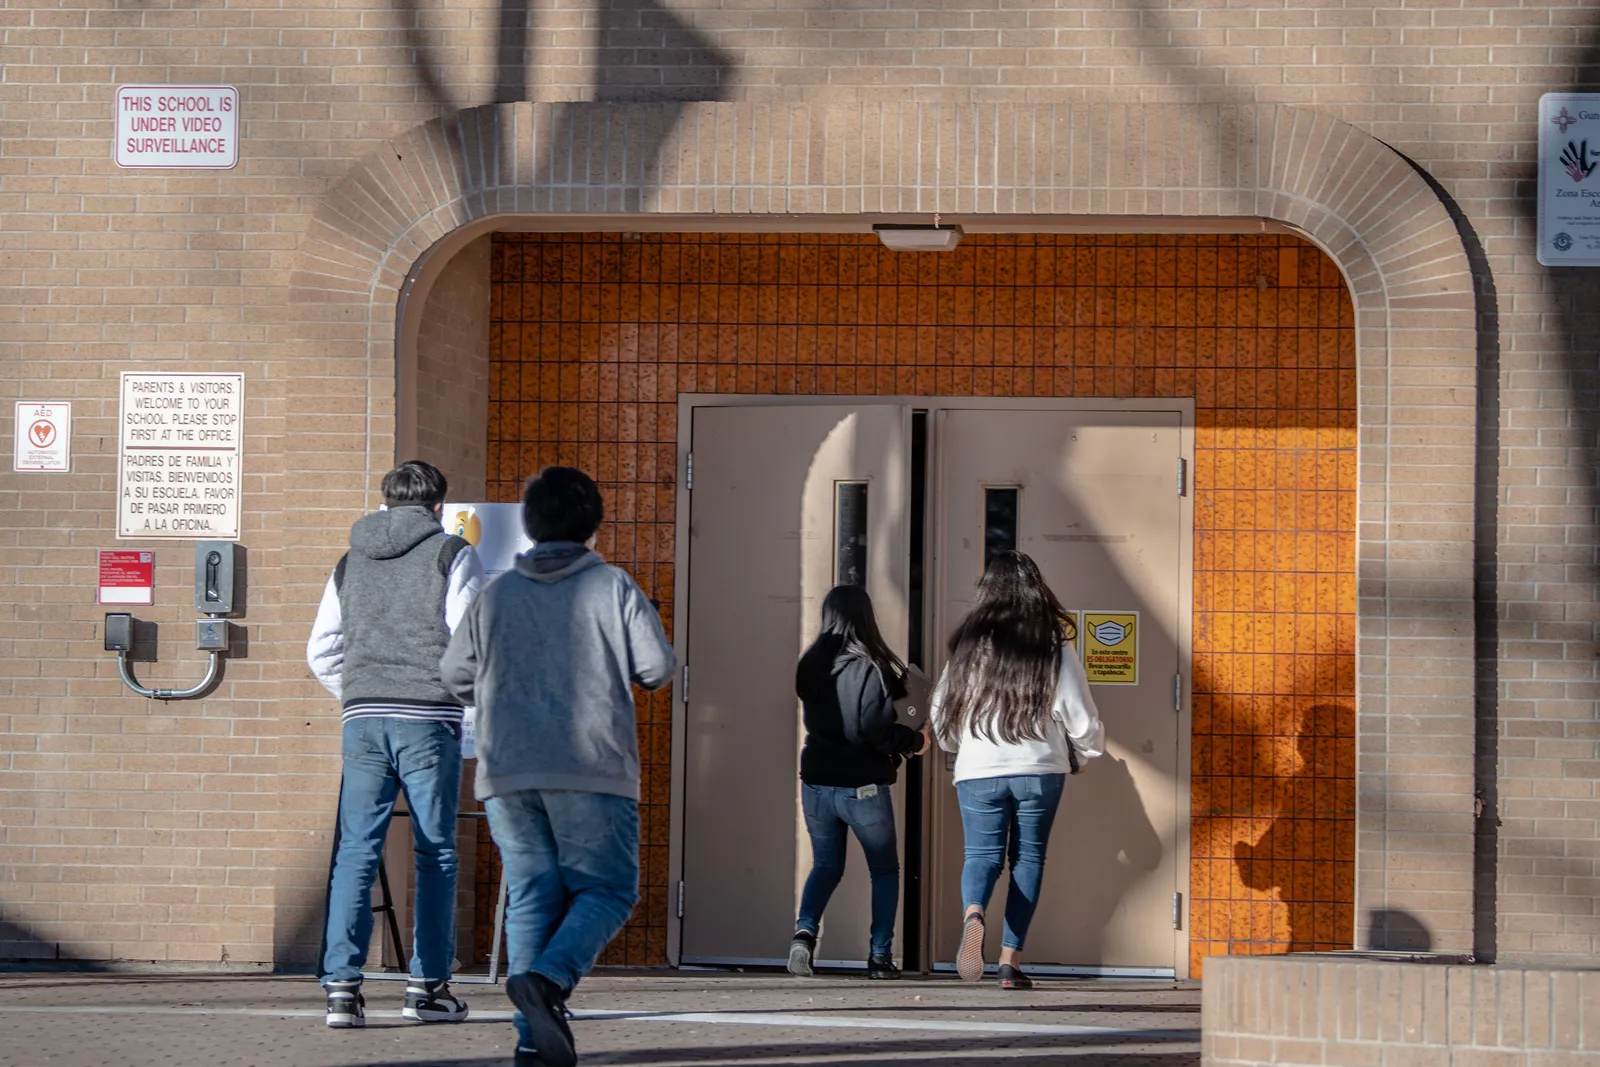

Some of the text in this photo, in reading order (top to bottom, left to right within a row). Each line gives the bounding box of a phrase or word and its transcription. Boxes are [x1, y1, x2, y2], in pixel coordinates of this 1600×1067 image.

[122, 96, 232, 112] THIS SCHOOL IS
[131, 117, 222, 132] UNDER VIDEO
[126, 138, 226, 153] SURVEILLANCE
[1555, 188, 1579, 198] Zona
[132, 381, 175, 393] PARENTS
[179, 382, 185, 394] &
[135, 397, 230, 410] WELCOME TO YOUR
[33, 409, 53, 417] AED
[172, 413, 208, 425] PLEASE
[212, 413, 237, 425] STOP
[130, 429, 234, 441] FIRST AT THE OFFICE.
[126, 455, 233, 468] PADRES DE FAMILIA Y
[126, 471, 233, 483] VISITAS. BIENVENIDOS
[124, 486, 235, 499] A SU ESCUELA. FAVOR
[130, 502, 227, 515] DE PASAR PRIMERO
[144, 519, 213, 530] A LA OFICINA.
